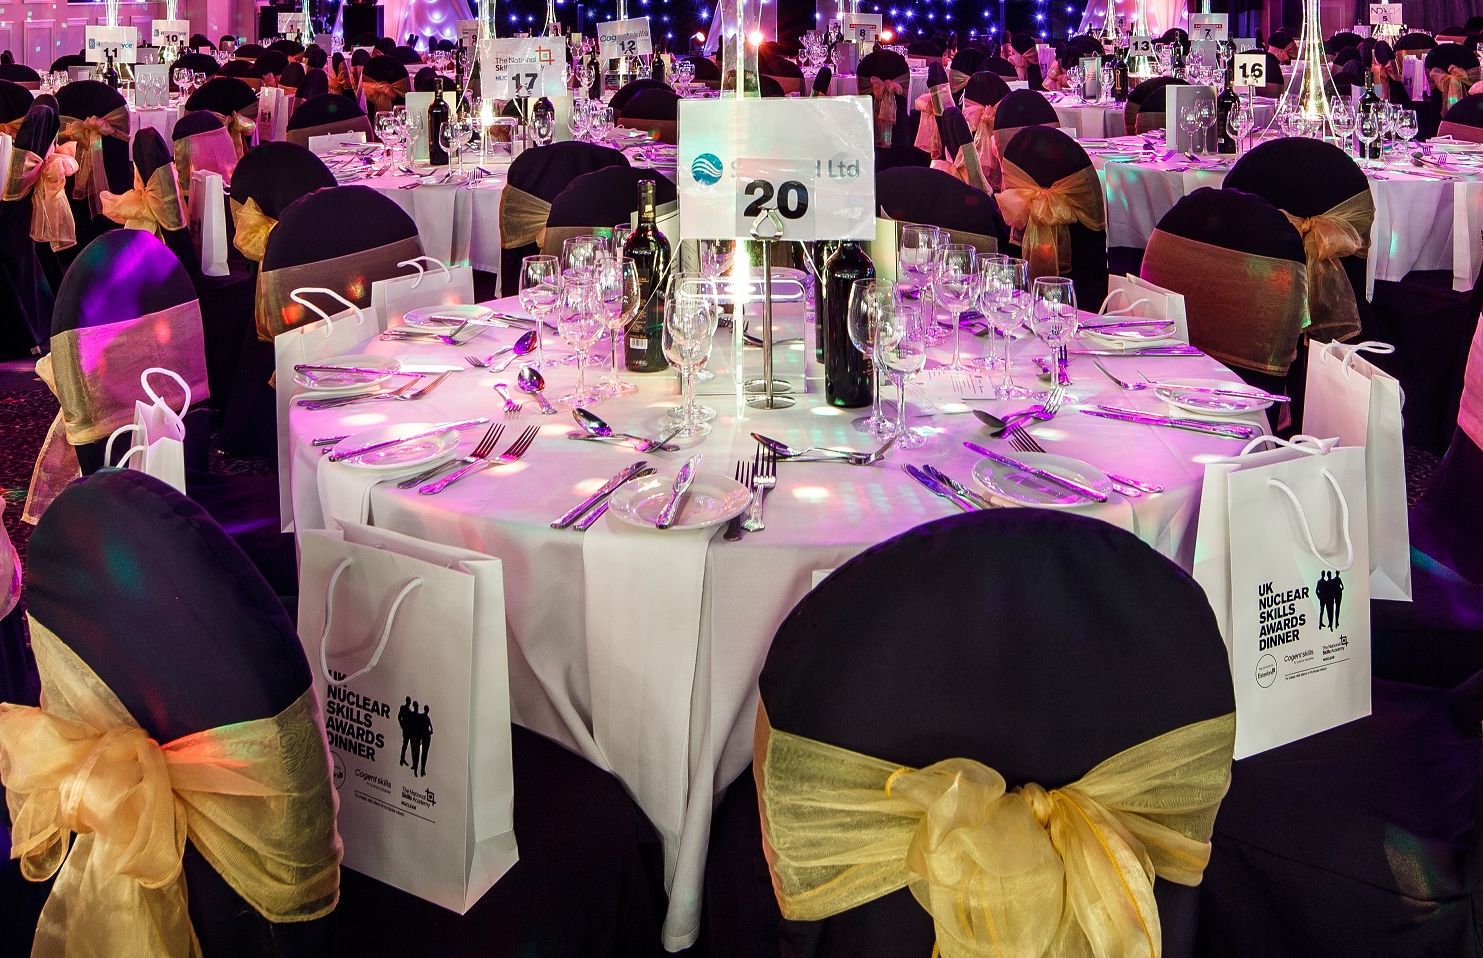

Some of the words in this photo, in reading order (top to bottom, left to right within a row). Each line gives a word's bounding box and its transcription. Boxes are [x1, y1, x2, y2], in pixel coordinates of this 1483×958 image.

[165, 34, 178, 43] 10
[859, 28, 866, 37] 8
[103, 47, 118, 58] 11
[619, 40, 636, 52] 12
[1132, 40, 1150, 52] 13
[1238, 62, 1264, 79] 16
[511, 72, 539, 90] 17
[827, 159, 860, 178] Ltd
[743, 179, 809, 220] 20
[1258, 581, 1274, 597] UK
[1258, 587, 1310, 611] NUCLEAR
[1259, 603, 1296, 625] SKILLS
[1259, 614, 1306, 639] AWARDS
[1259, 629, 1300, 652] DINNER
[1283, 652, 1302, 663] Cogent
[1302, 649, 1315, 657] skills
[326, 684, 391, 719] NUCLEAR
[326, 700, 373, 728] SKILLS
[326, 715, 385, 749] AWARDS
[327, 730, 376, 762] DINNER
[354, 768, 377, 783] Cogent
[377, 777, 392, 789] skills
[401, 792, 412, 801] Skills
[412, 796, 431, 809] Academy
